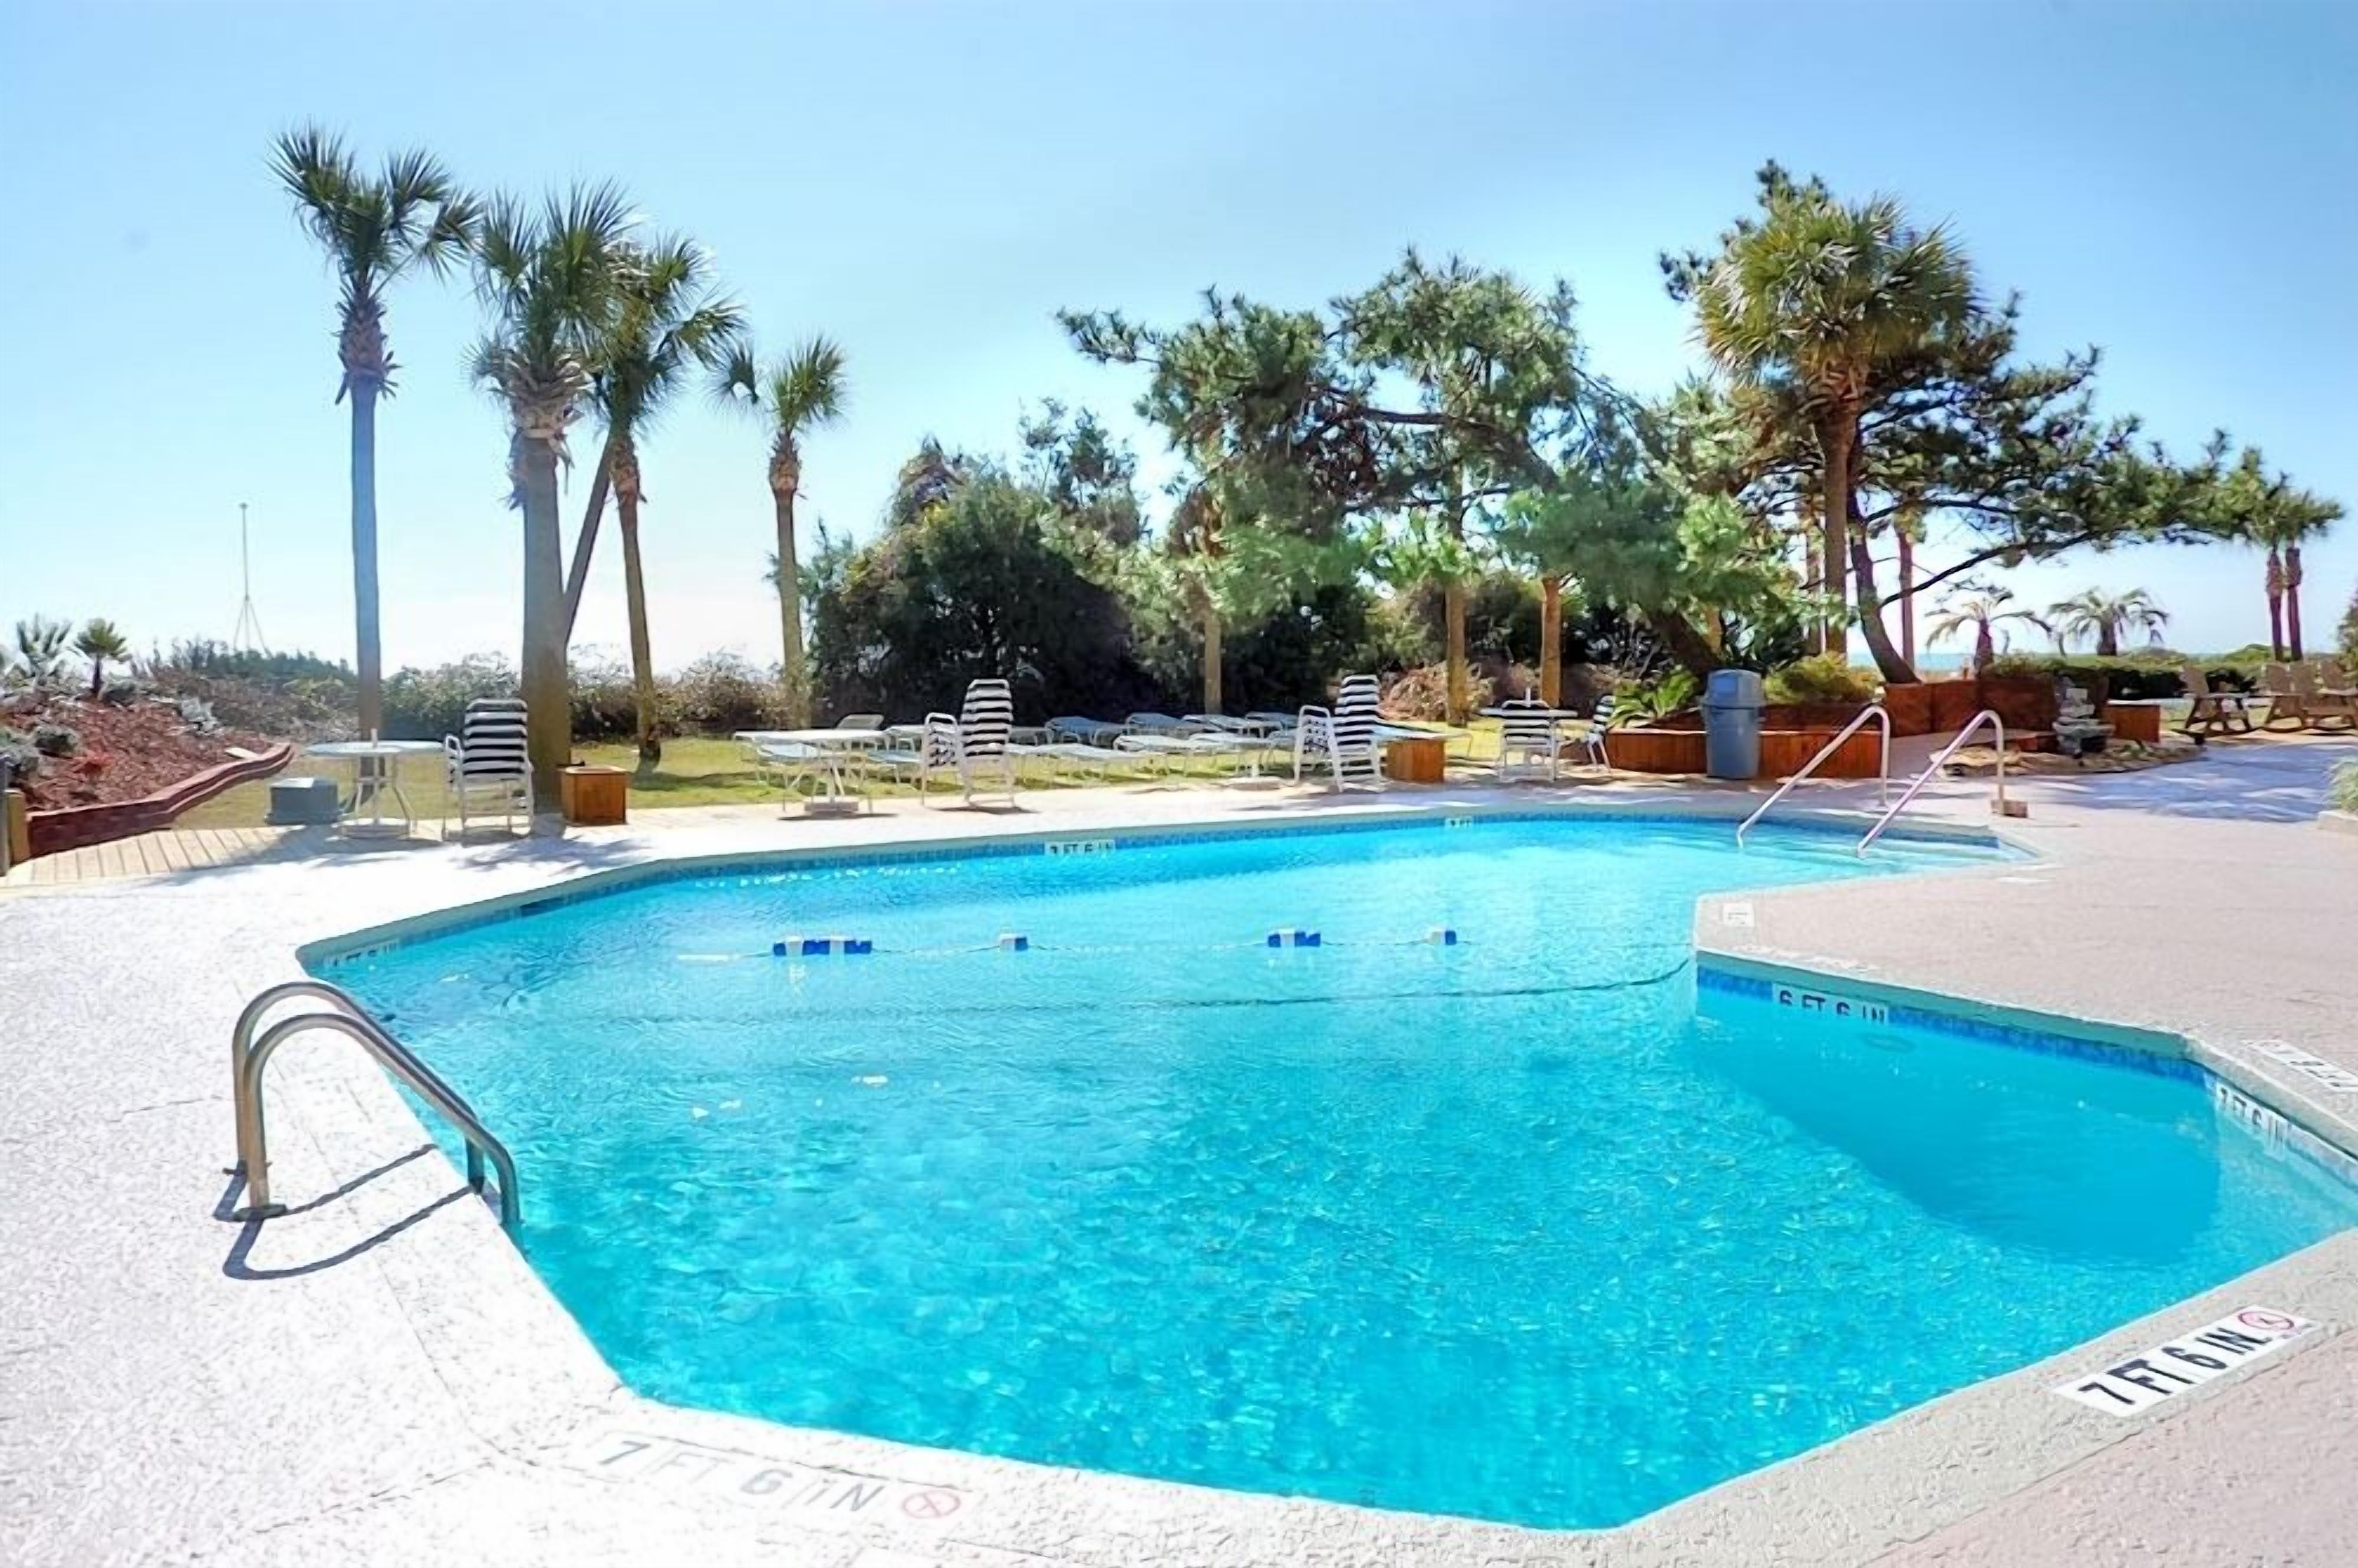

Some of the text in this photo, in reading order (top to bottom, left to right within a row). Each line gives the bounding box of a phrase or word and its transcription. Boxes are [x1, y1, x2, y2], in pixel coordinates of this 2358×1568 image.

[1802, 994, 1826, 1012] FT
[2195, 1327, 2274, 1356] IN
[2161, 1346, 2228, 1370] 6
[2106, 1358, 2194, 1396] FT
[2077, 1382, 2136, 1405] 7
[598, 1440, 885, 1511] 7 FT 6 IN
